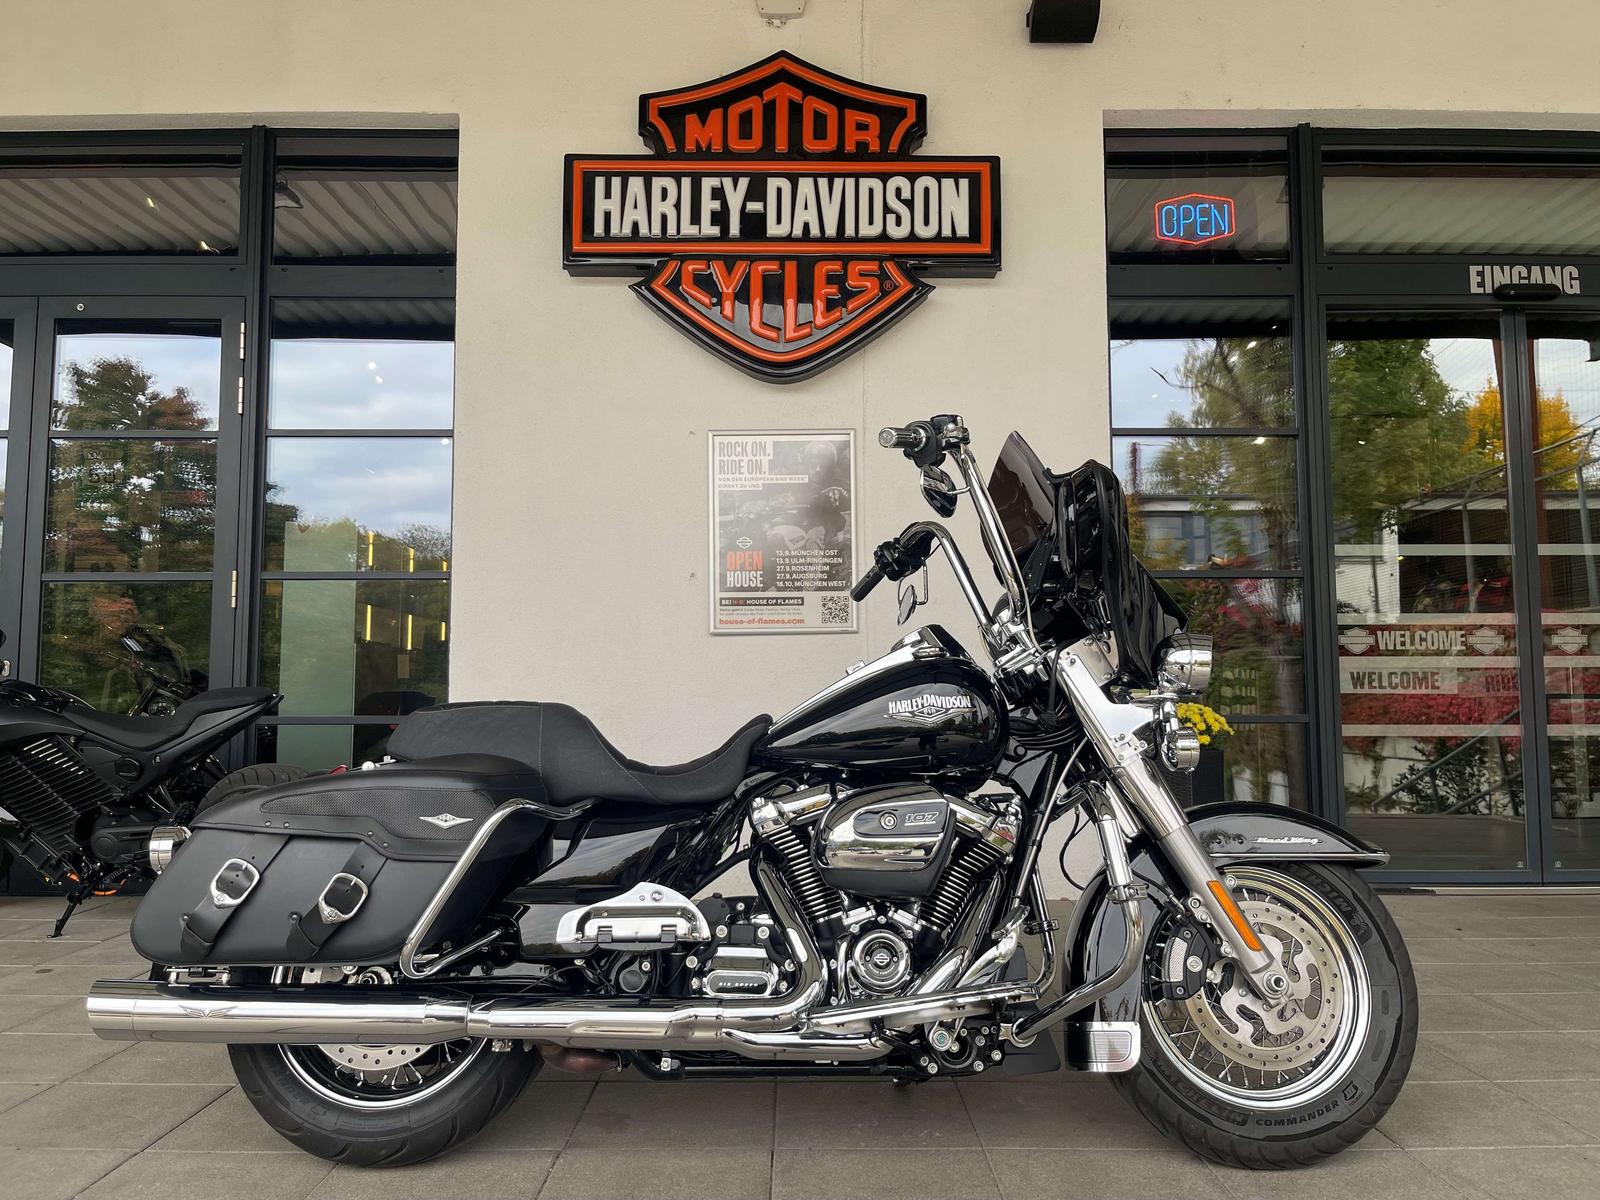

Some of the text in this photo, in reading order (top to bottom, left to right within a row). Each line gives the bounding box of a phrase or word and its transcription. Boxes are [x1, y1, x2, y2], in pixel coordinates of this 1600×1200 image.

[684, 82, 880, 153] MOTOR
[593, 175, 970, 239] HARLEY-DAVIDSON
[1162, 204, 1228, 236] OPEN
[1469, 265, 1580, 294] EINGANG
[681, 260, 881, 343] CYCLES
[718, 441, 771, 457] ROCK ON.
[718, 459, 767, 475] RIDE ON.
[726, 551, 763, 571] OPEN
[726, 571, 764, 588] HOUSE
[1377, 630, 1466, 650] WELCOME
[1350, 671, 1440, 690] WELCOME
[888, 694, 972, 714] HARLEY-DAVIDSON
[905, 812, 939, 823] 107
[1255, 1100, 1340, 1127] COMMANDER
